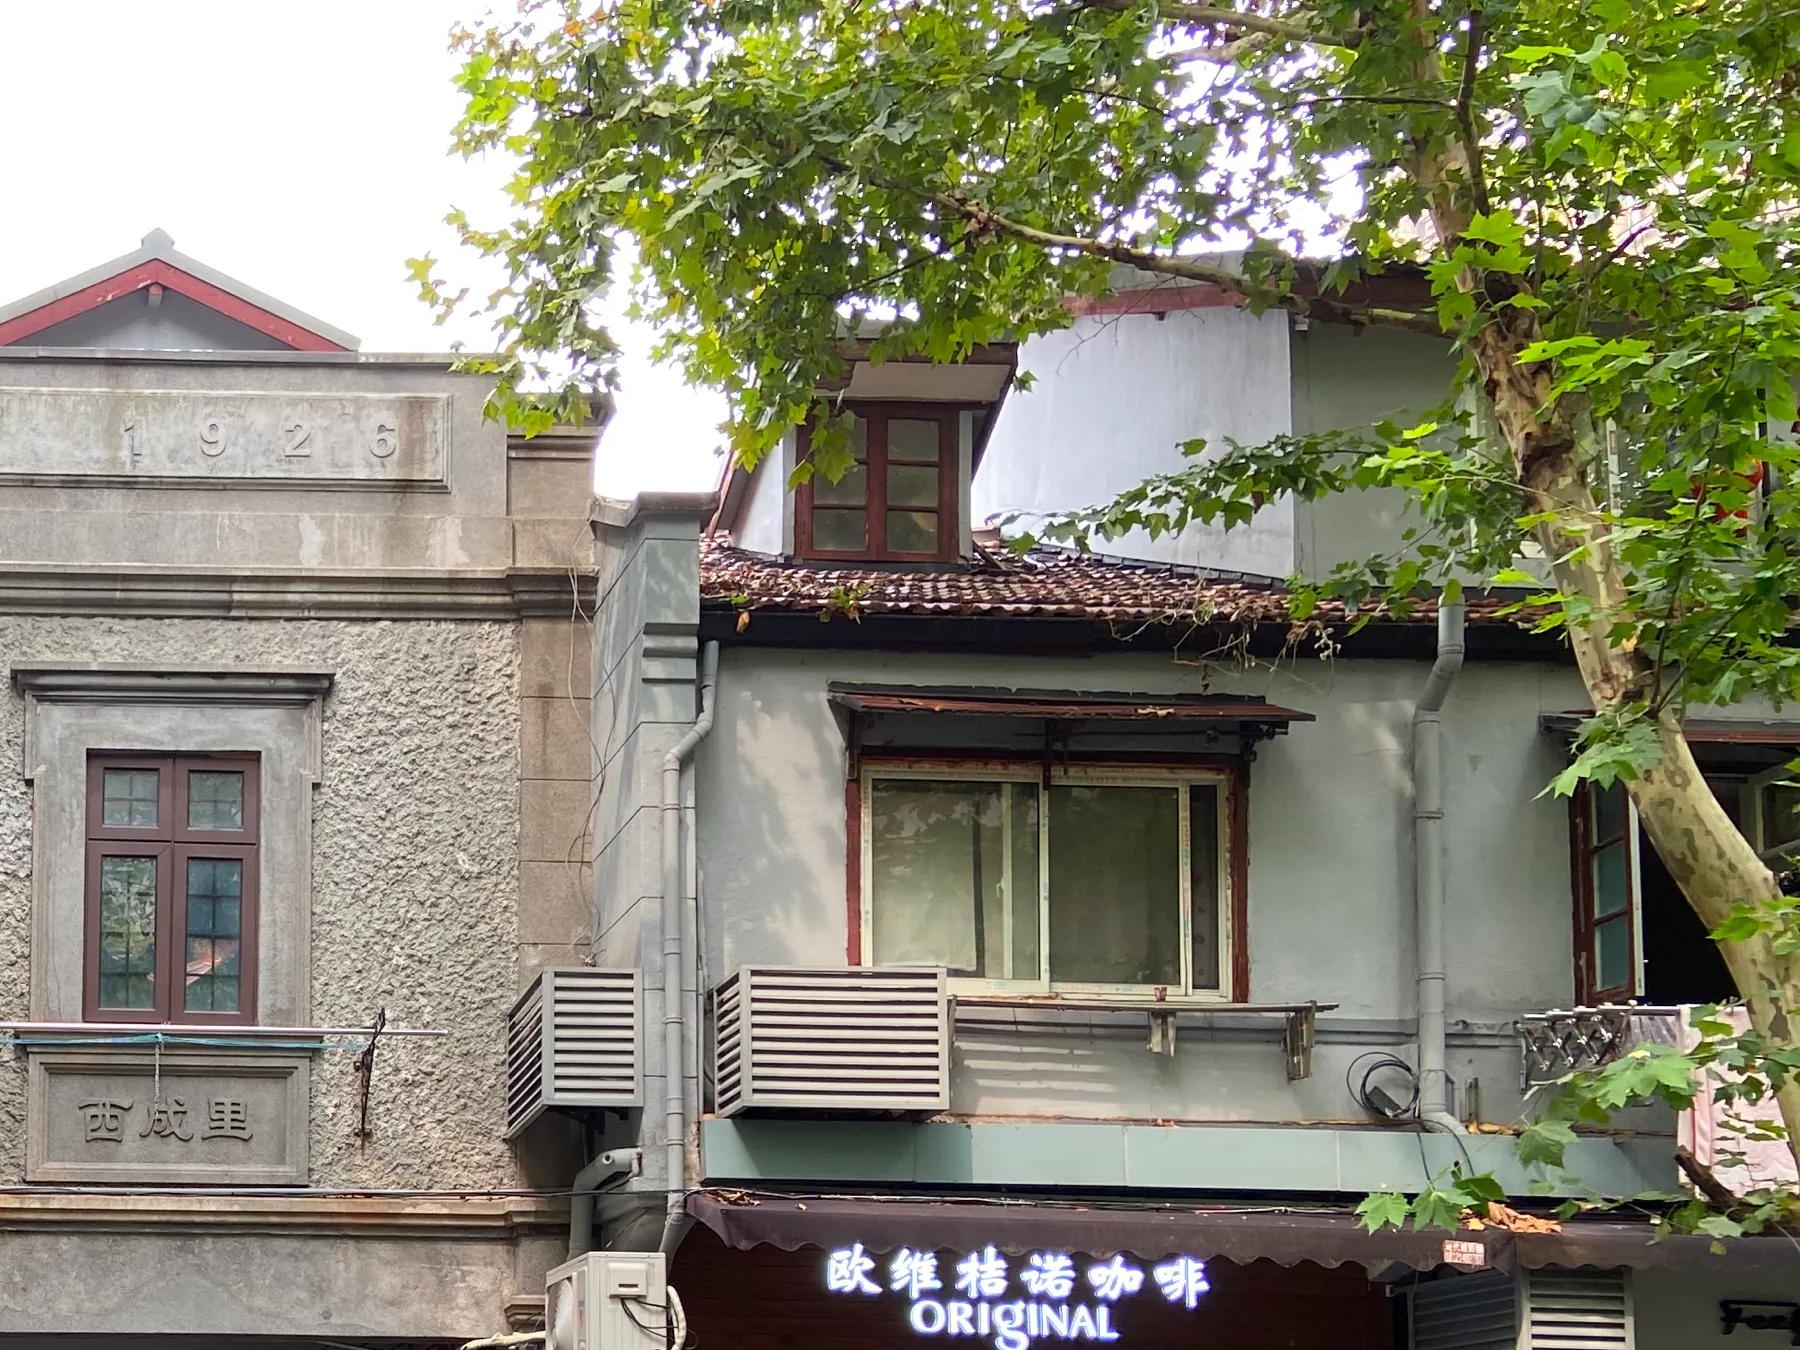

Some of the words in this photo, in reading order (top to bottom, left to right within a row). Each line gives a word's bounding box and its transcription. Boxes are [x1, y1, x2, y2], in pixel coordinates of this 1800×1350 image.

[123, 422, 397, 459] 1926
[78, 1098, 253, 1143] 西成里
[827, 1242, 1211, 1308] 欧维桔诺咖啡
